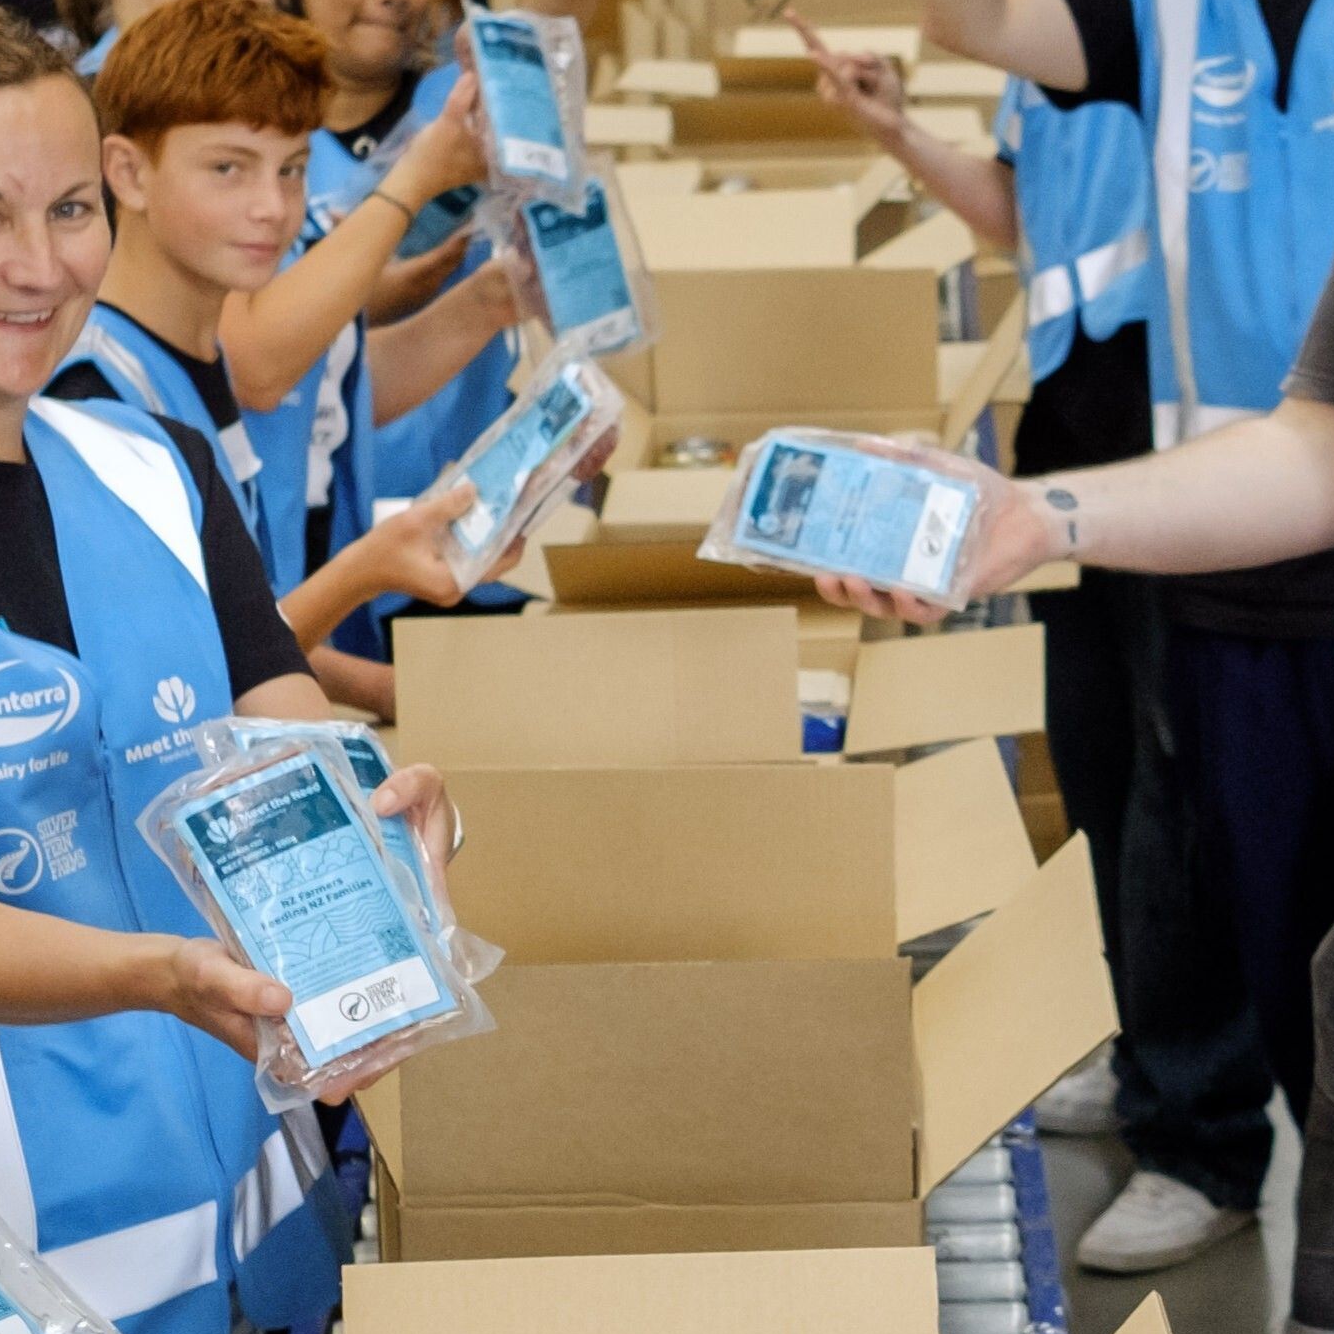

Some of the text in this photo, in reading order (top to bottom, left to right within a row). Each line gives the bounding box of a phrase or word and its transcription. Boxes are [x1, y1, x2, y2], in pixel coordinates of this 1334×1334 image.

[28, 757, 50, 773] for
[50, 750, 69, 767] life
[126, 728, 194, 763] Meet th
[281, 877, 343, 909] NZ Farmers
[309, 896, 325, 910] NZ
[326, 878, 373, 904] Families
